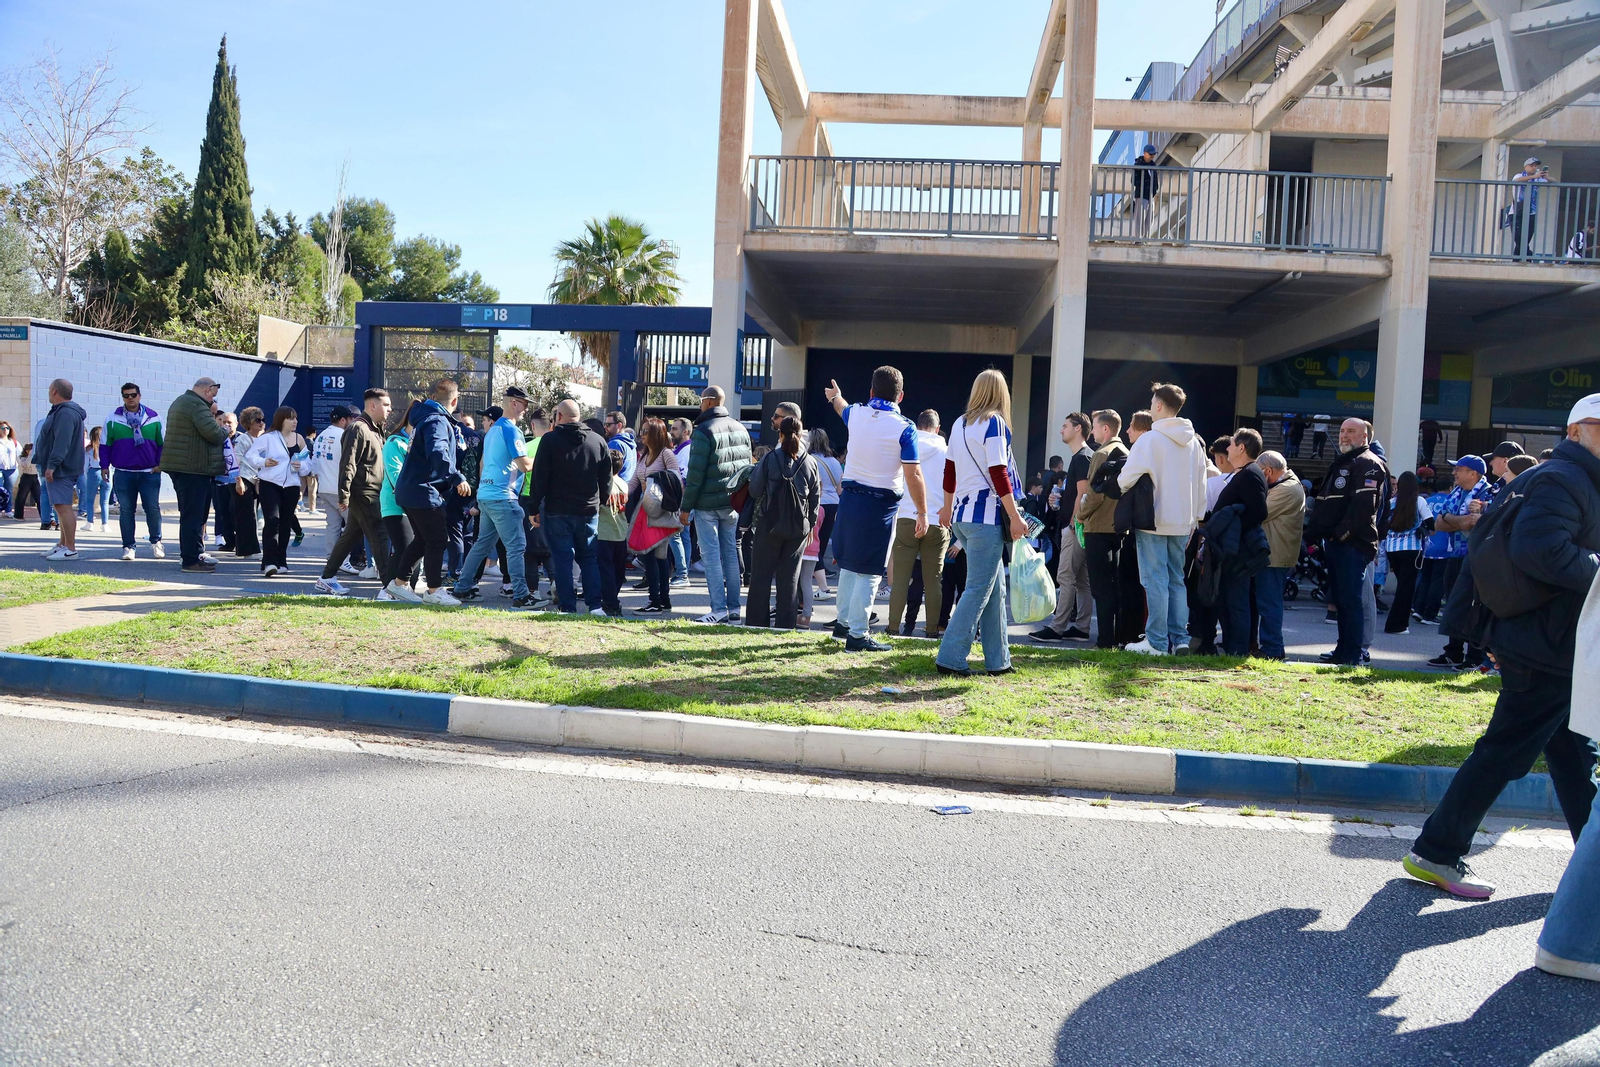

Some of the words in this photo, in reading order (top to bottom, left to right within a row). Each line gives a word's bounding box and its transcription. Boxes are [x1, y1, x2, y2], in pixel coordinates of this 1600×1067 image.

[484, 308, 508, 321] P18
[1295, 357, 1321, 370] Olin
[322, 376, 345, 388] P18
[1549, 367, 1592, 388] Olin
